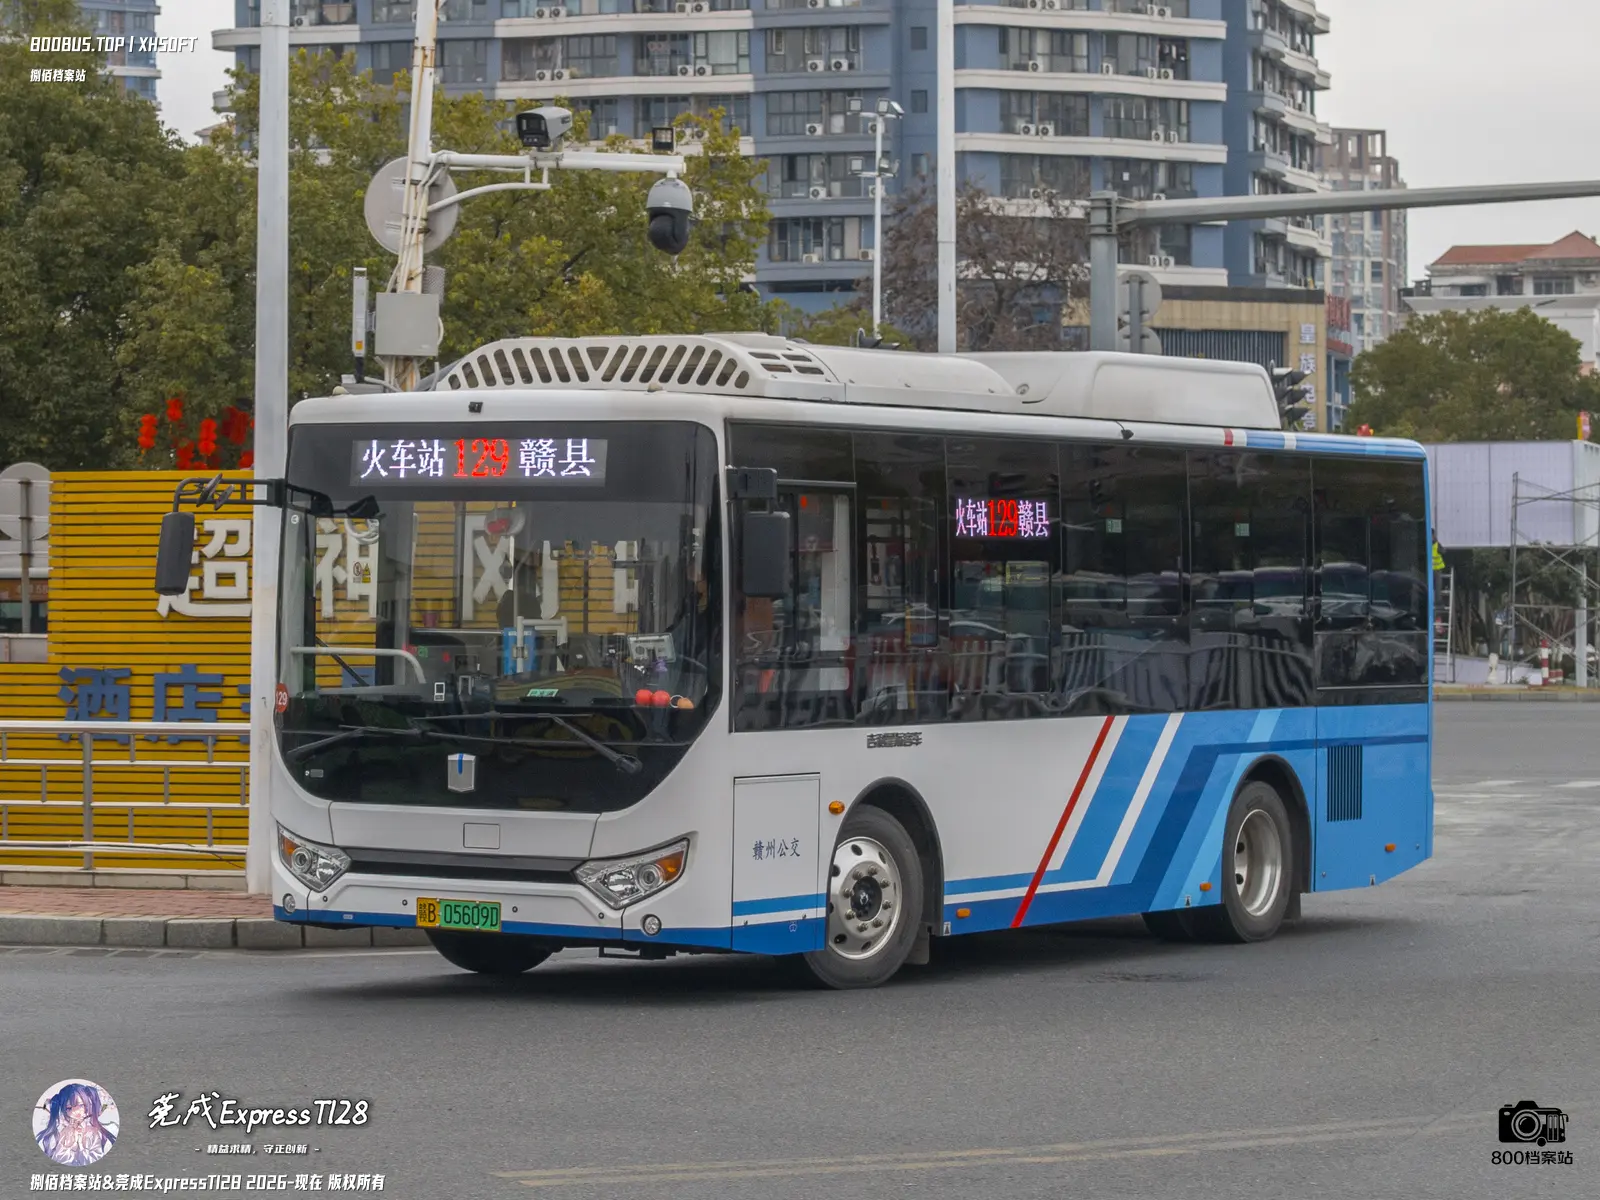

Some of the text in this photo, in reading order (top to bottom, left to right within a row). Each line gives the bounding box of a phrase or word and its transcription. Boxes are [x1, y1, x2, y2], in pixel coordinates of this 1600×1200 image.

[360, 438, 596, 479] 火车站 129 赣县
[752, 837, 801, 861] 赣州公交
